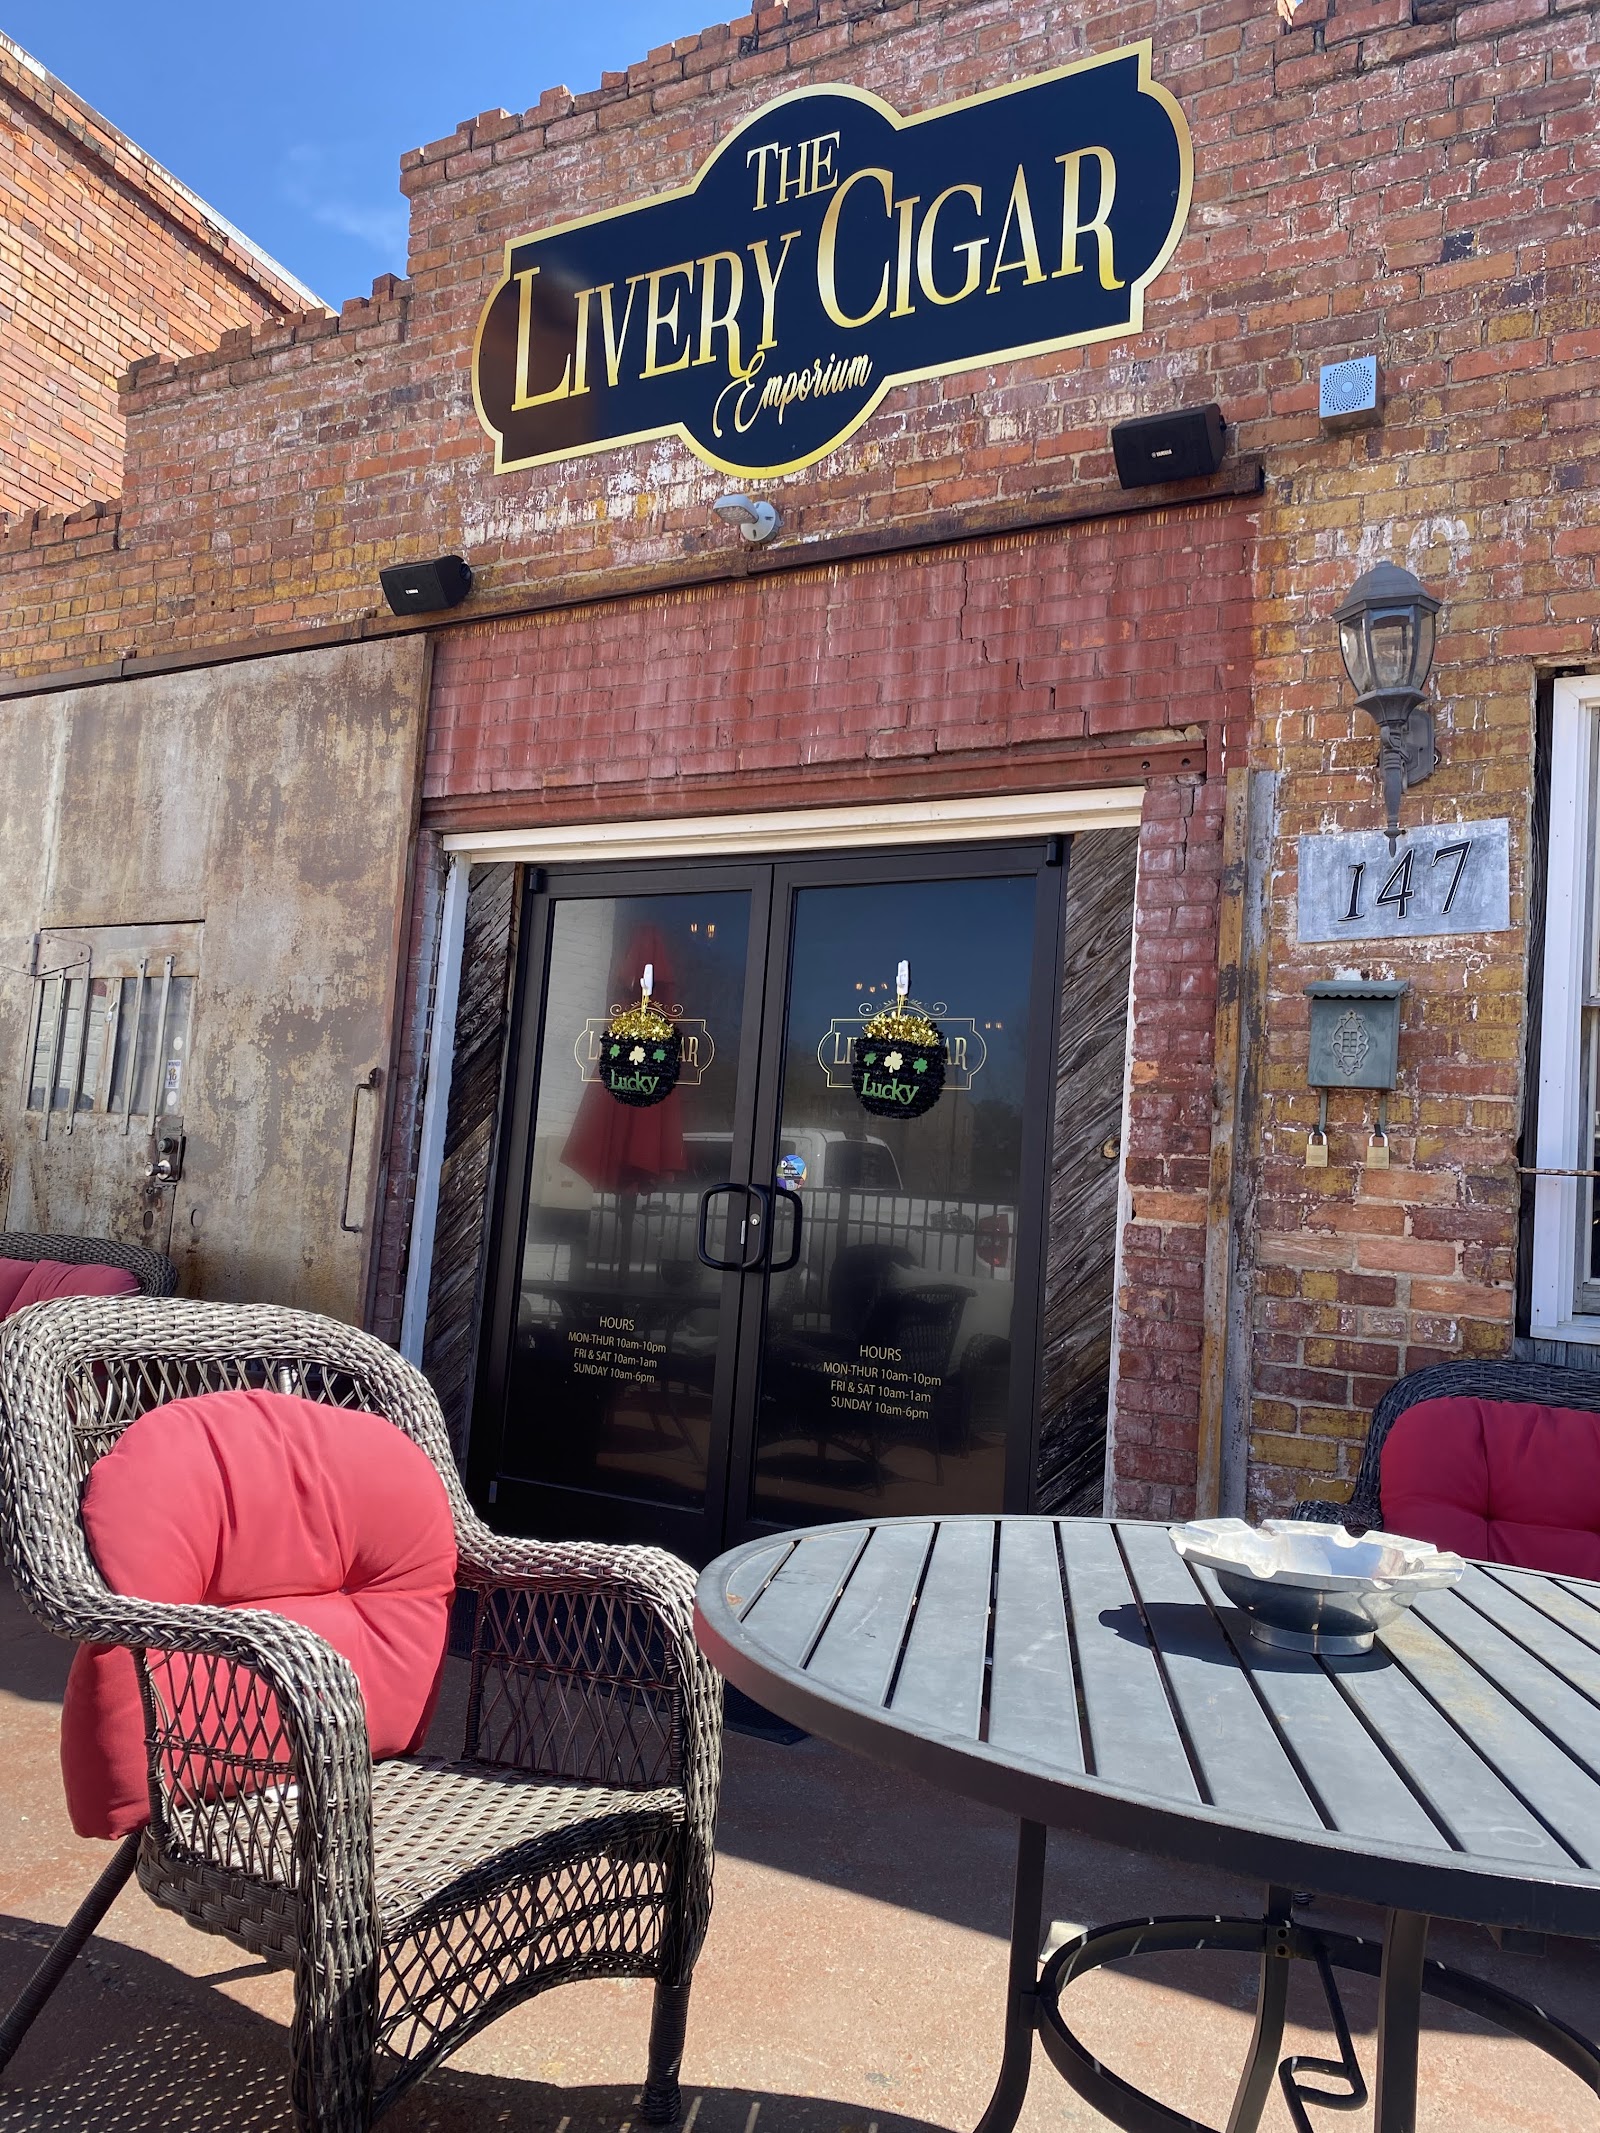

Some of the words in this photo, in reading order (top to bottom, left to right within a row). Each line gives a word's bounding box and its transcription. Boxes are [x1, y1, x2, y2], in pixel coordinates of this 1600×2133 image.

[746, 130, 841, 212] THE
[511, 230, 802, 412] LIVERY
[816, 145, 1125, 329] CIGAR
[712, 350, 874, 439] Emporium
[1337, 840, 1472, 922] 147
[609, 1069, 660, 1095] Lucky
[861, 1072, 919, 1105] Lucky
[599, 1315, 635, 1331] HOURS
[568, 1331, 615, 1347] MON-THUR
[616, 1337, 667, 1354] 10am-10pm
[860, 1344, 902, 1362] HOURS
[574, 1348, 587, 1359] FRI
[587, 1349, 595, 1360] &
[596, 1351, 612, 1362] SAT
[613, 1353, 658, 1368] 10am-1am
[573, 1362, 609, 1377] SUNDAY
[610, 1368, 655, 1384] 10am-6pm
[823, 1361, 879, 1379] MON-THUR
[881, 1368, 942, 1387] 10am-10pm
[830, 1379, 846, 1392] FRI
[847, 1381, 856, 1393] &
[857, 1383, 876, 1396] SAT
[878, 1385, 932, 1403] 10am-1am
[831, 1396, 873, 1412] SUNDAY
[875, 1402, 929, 1420] 10am-6pm
